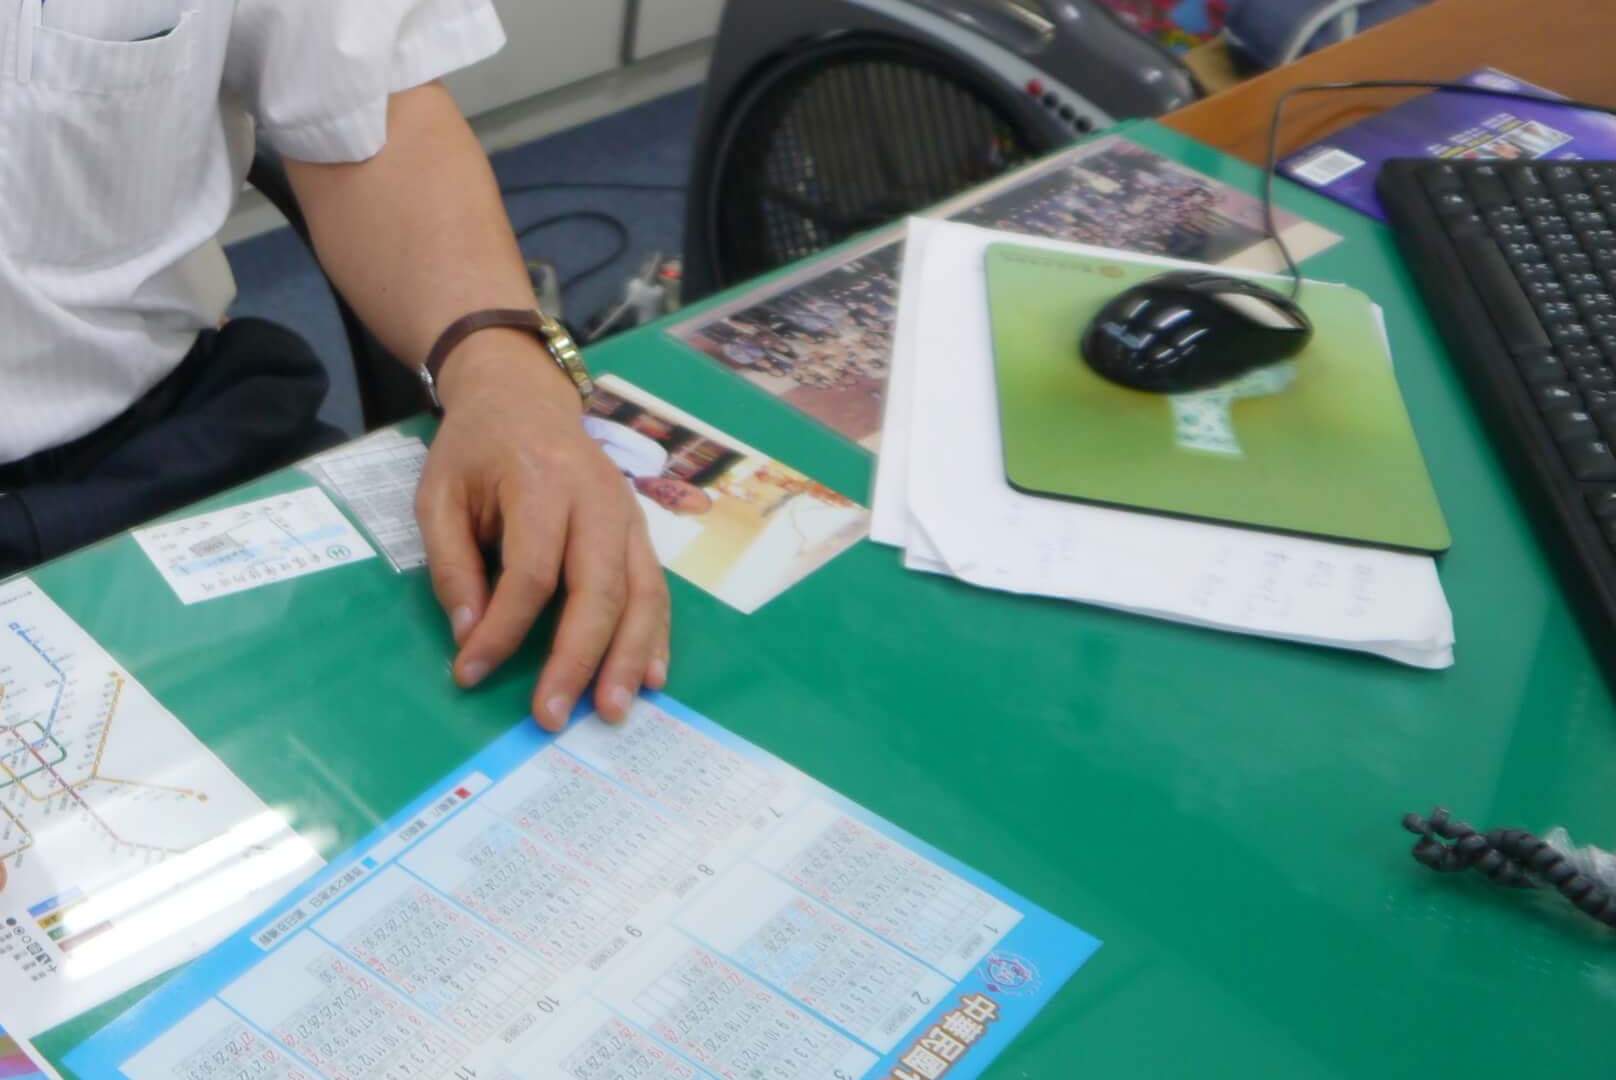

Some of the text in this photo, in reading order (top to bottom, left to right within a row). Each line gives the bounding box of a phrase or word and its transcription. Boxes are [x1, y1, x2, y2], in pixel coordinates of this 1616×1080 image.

[764, 805, 784, 818] 7
[694, 862, 716, 876] 8
[623, 924, 644, 938] 9
[982, 923, 1001, 934] 1
[533, 994, 562, 1013] 10
[908, 990, 931, 1005] 2
[452, 1065, 478, 1080] 11
